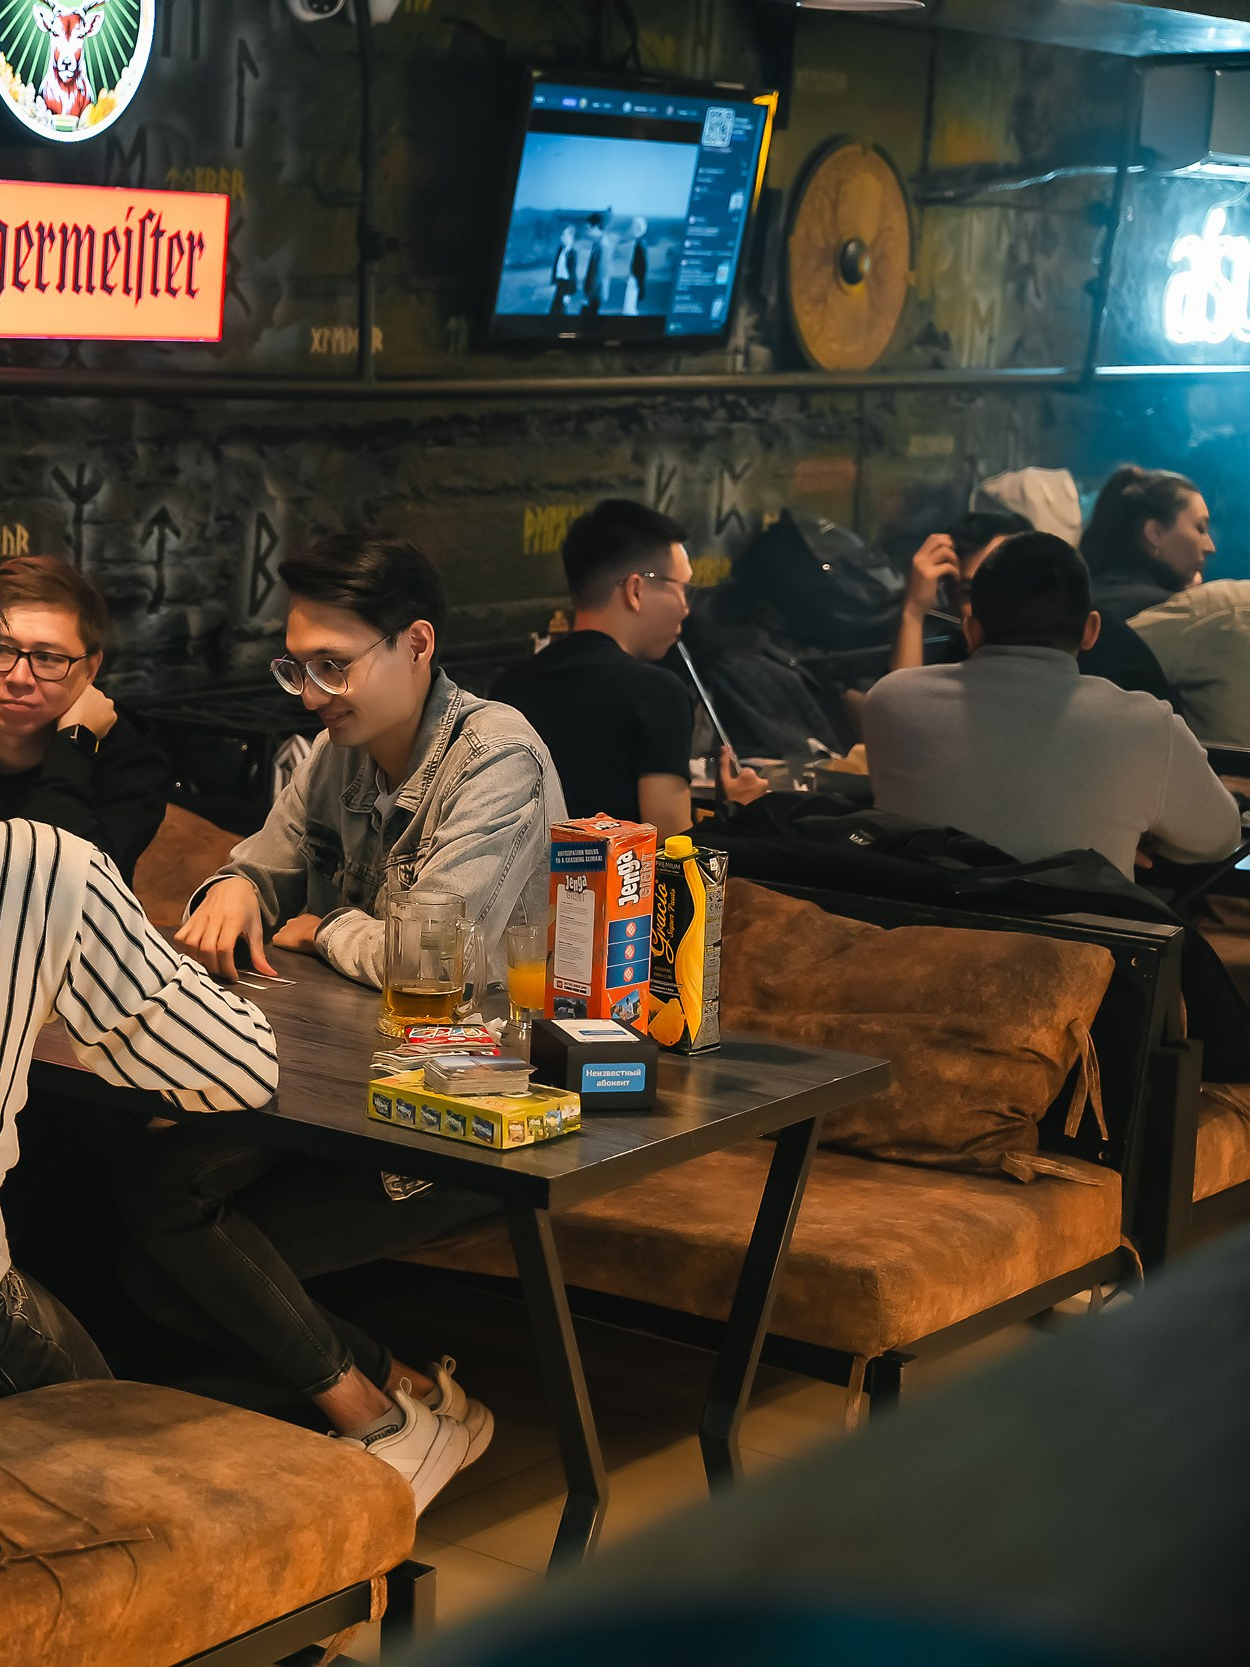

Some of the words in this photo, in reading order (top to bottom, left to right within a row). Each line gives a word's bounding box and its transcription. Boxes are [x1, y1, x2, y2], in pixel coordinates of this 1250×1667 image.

[656, 861, 680, 870] PREMIUM
[565, 875, 587, 893] Jenga
[616, 850, 643, 907] Jenga
[651, 883, 674, 964] Gracio
[586, 1068, 642, 1077] Неизвестный
